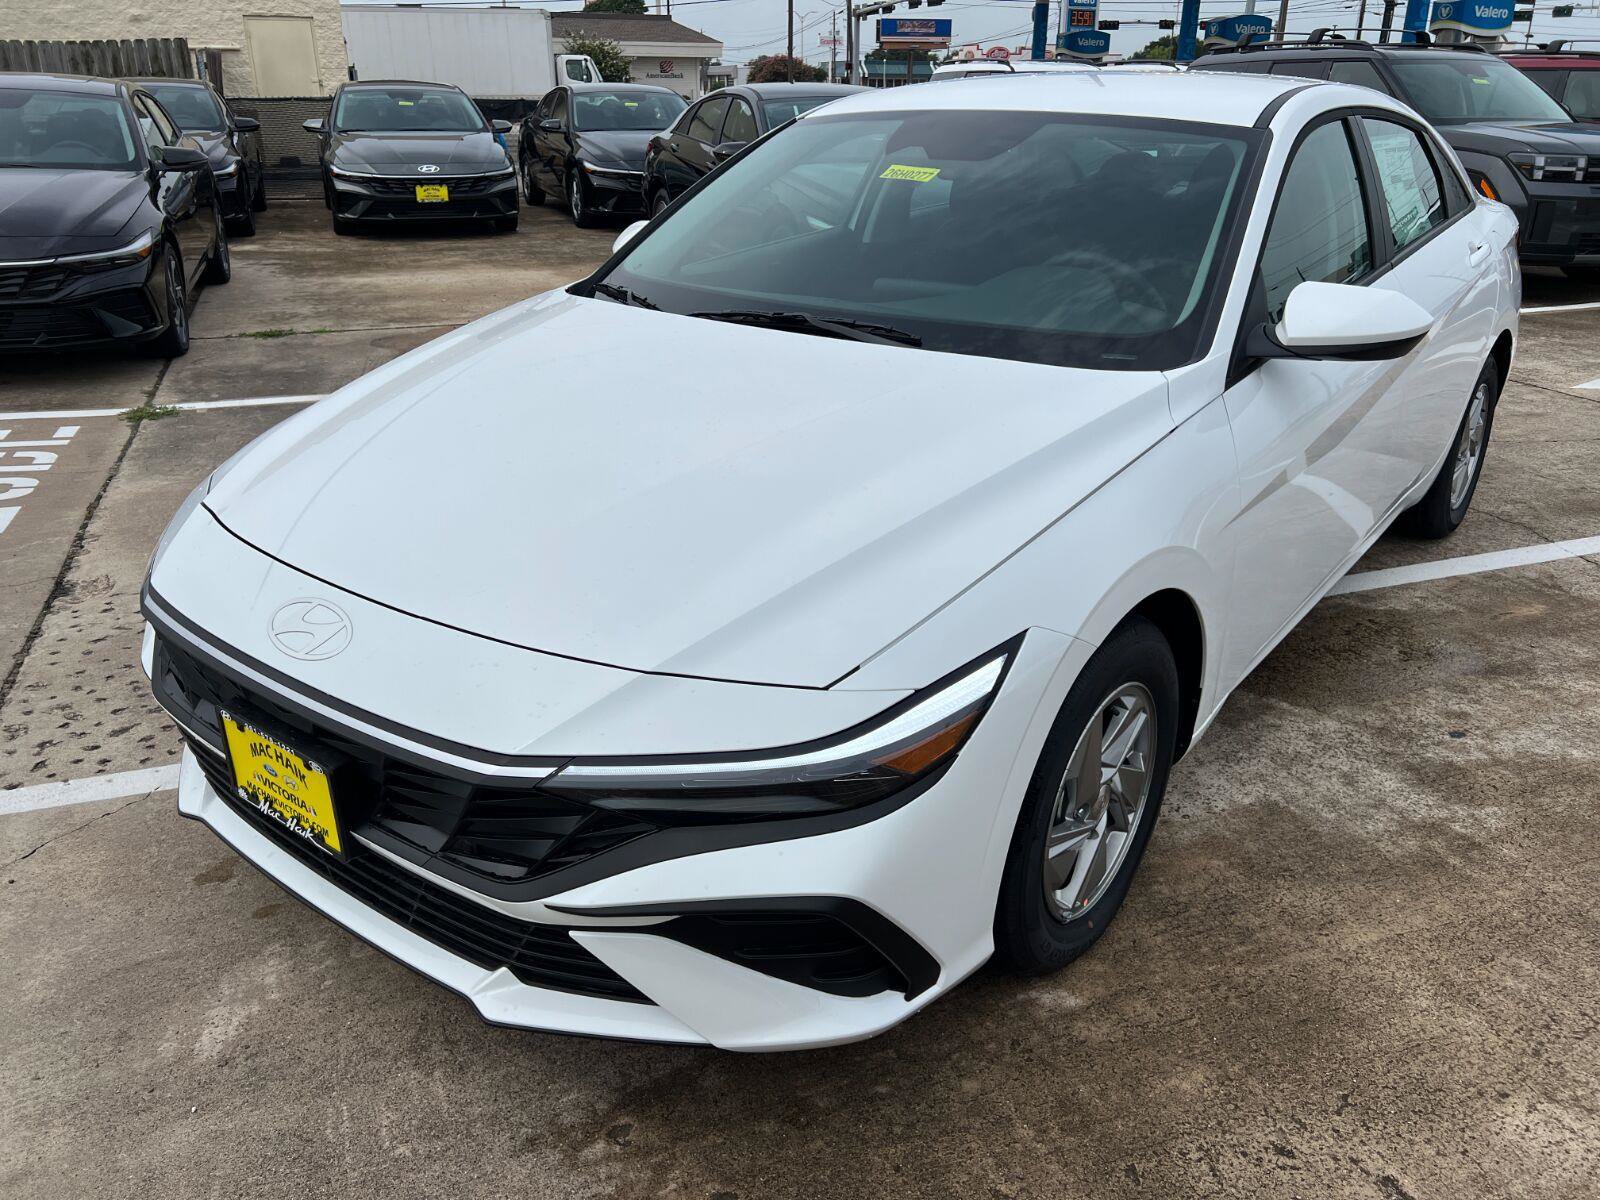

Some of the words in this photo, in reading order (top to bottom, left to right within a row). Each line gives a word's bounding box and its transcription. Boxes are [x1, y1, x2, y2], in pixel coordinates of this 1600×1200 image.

[1475, 5, 1509, 19] Valero
[1235, 23, 1266, 34] Valero
[1078, 37, 1105, 47] Valero
[883, 168, 935, 181] 26H0277
[249, 742, 273, 760] MAC
[274, 748, 309, 791] HAIK
[260, 774, 309, 813] VICTORIA
[258, 798, 283, 820] Mac
